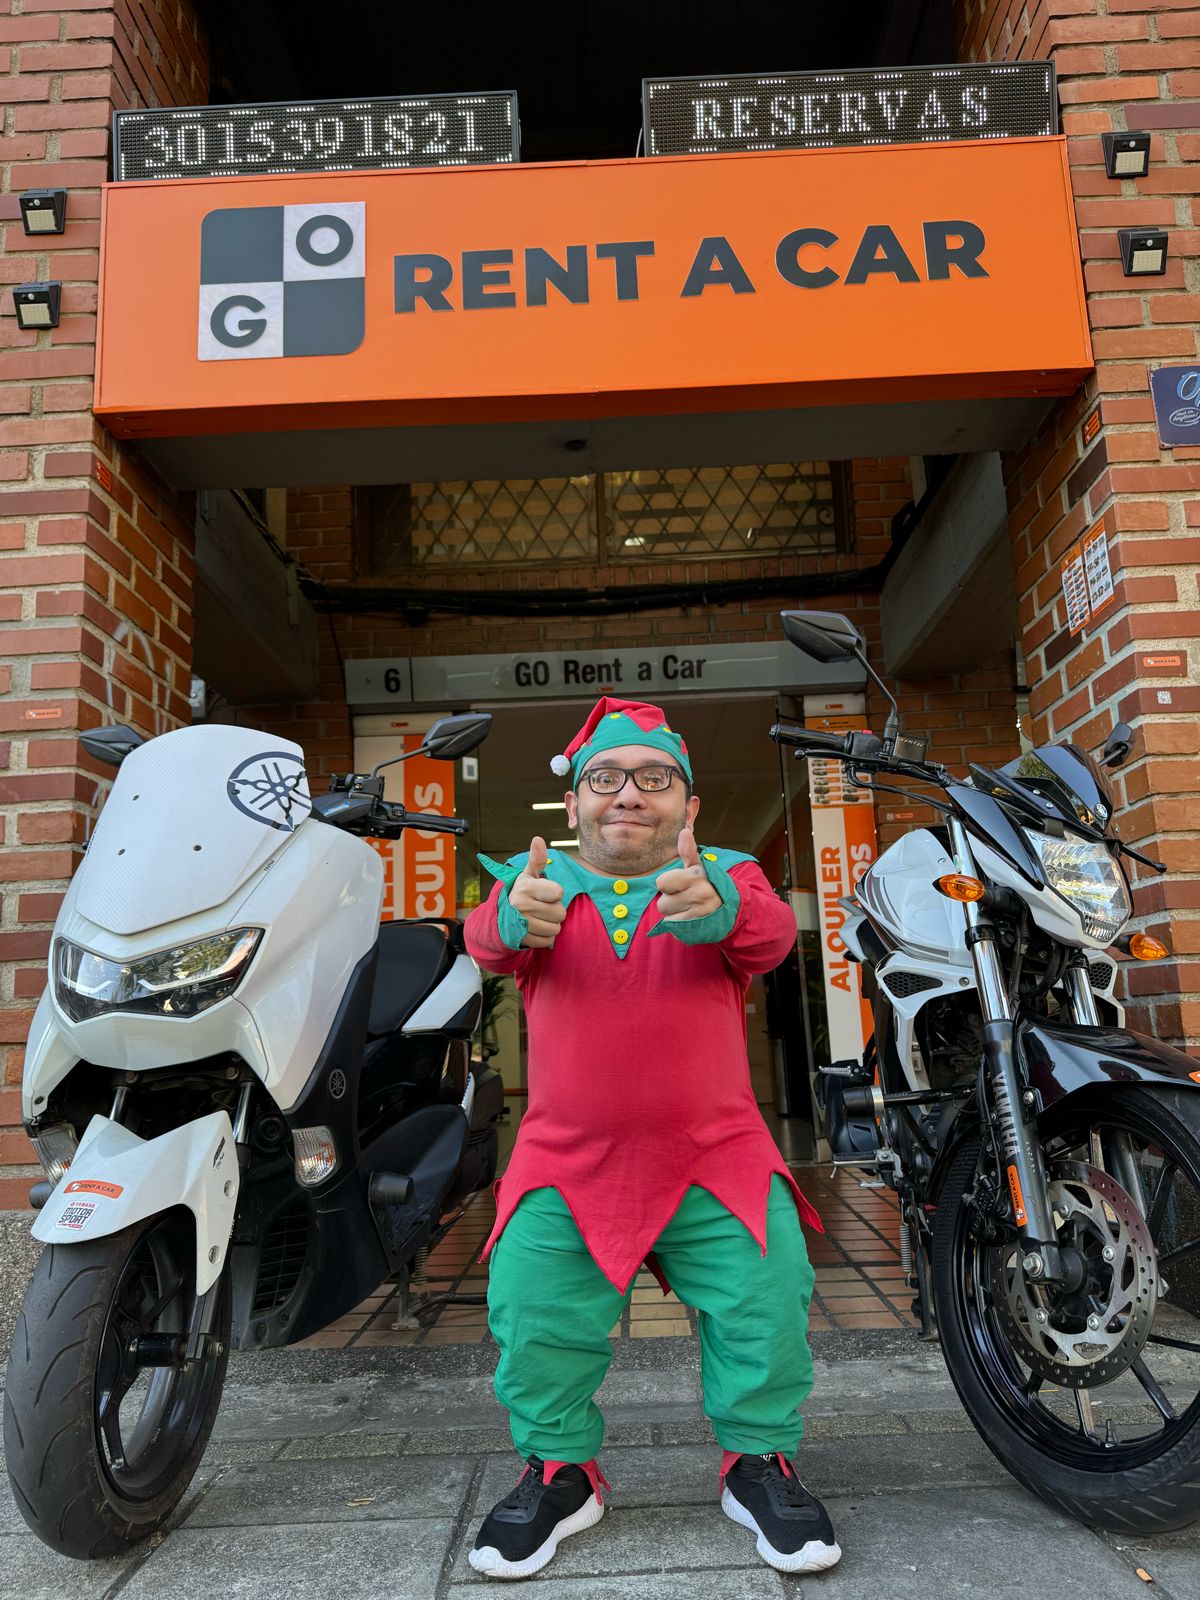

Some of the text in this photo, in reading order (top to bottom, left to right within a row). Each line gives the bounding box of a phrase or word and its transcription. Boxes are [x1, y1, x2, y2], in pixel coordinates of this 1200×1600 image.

[144, 111, 484, 169] 3015391821
[692, 85, 990, 140] RESERVAS
[394, 219, 991, 313] RENT A CAR
[384, 668, 400, 693] 6
[514, 654, 707, 687] GO Rent a Car
[820, 846, 851, 992] ALQUILER
[992, 1070, 1021, 1161] YAMAHA
[58, 1215, 89, 1224] SPORT
[64, 1208, 93, 1216] MOTOR
